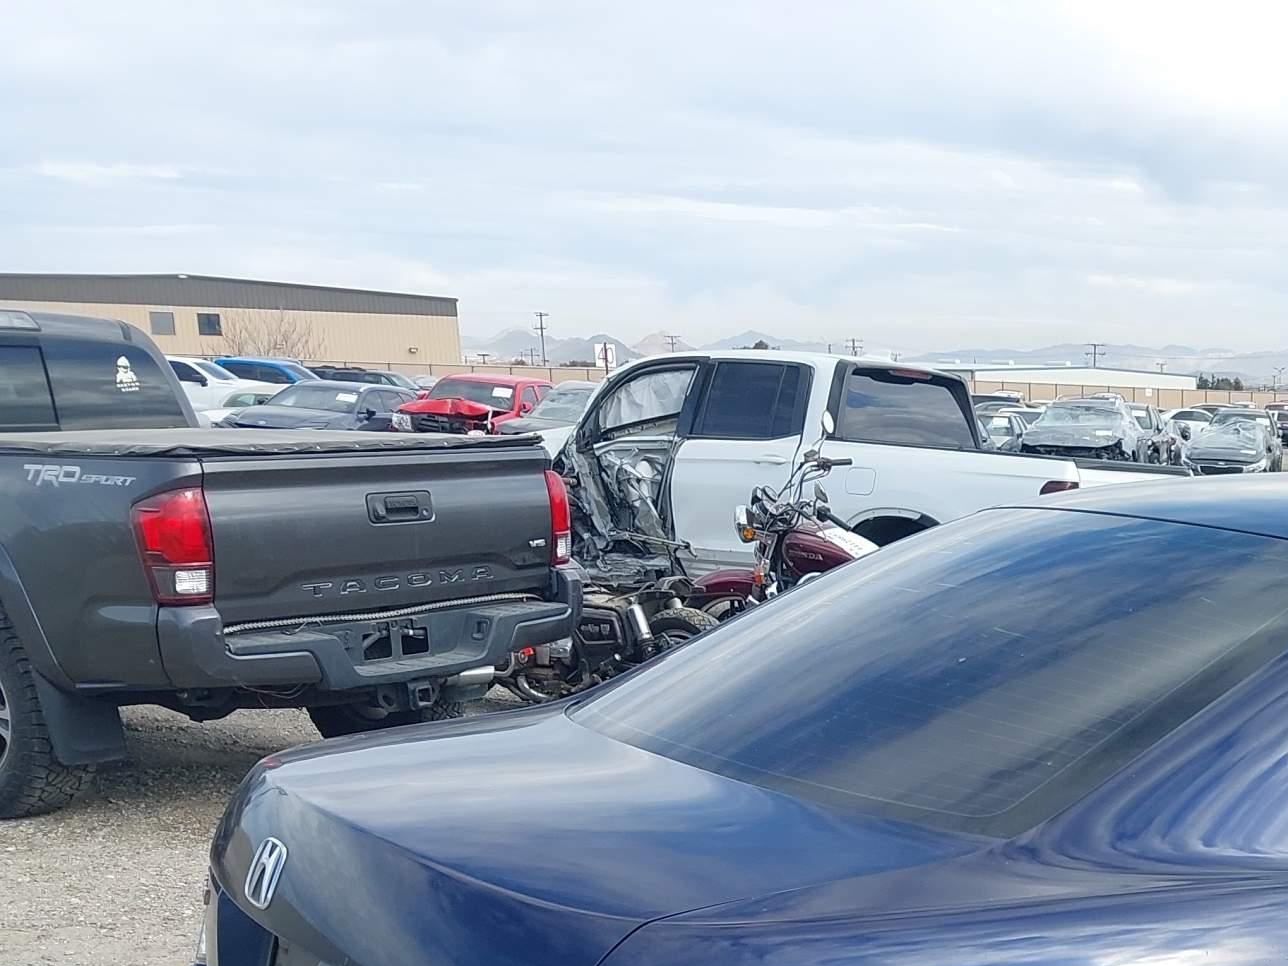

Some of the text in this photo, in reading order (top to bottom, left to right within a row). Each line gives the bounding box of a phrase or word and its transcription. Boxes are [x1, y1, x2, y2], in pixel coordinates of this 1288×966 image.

[597, 346, 615, 365] 40
[23, 463, 137, 488] TRD SPORT
[787, 547, 824, 561] NDA
[301, 563, 496, 598] TACOMA
